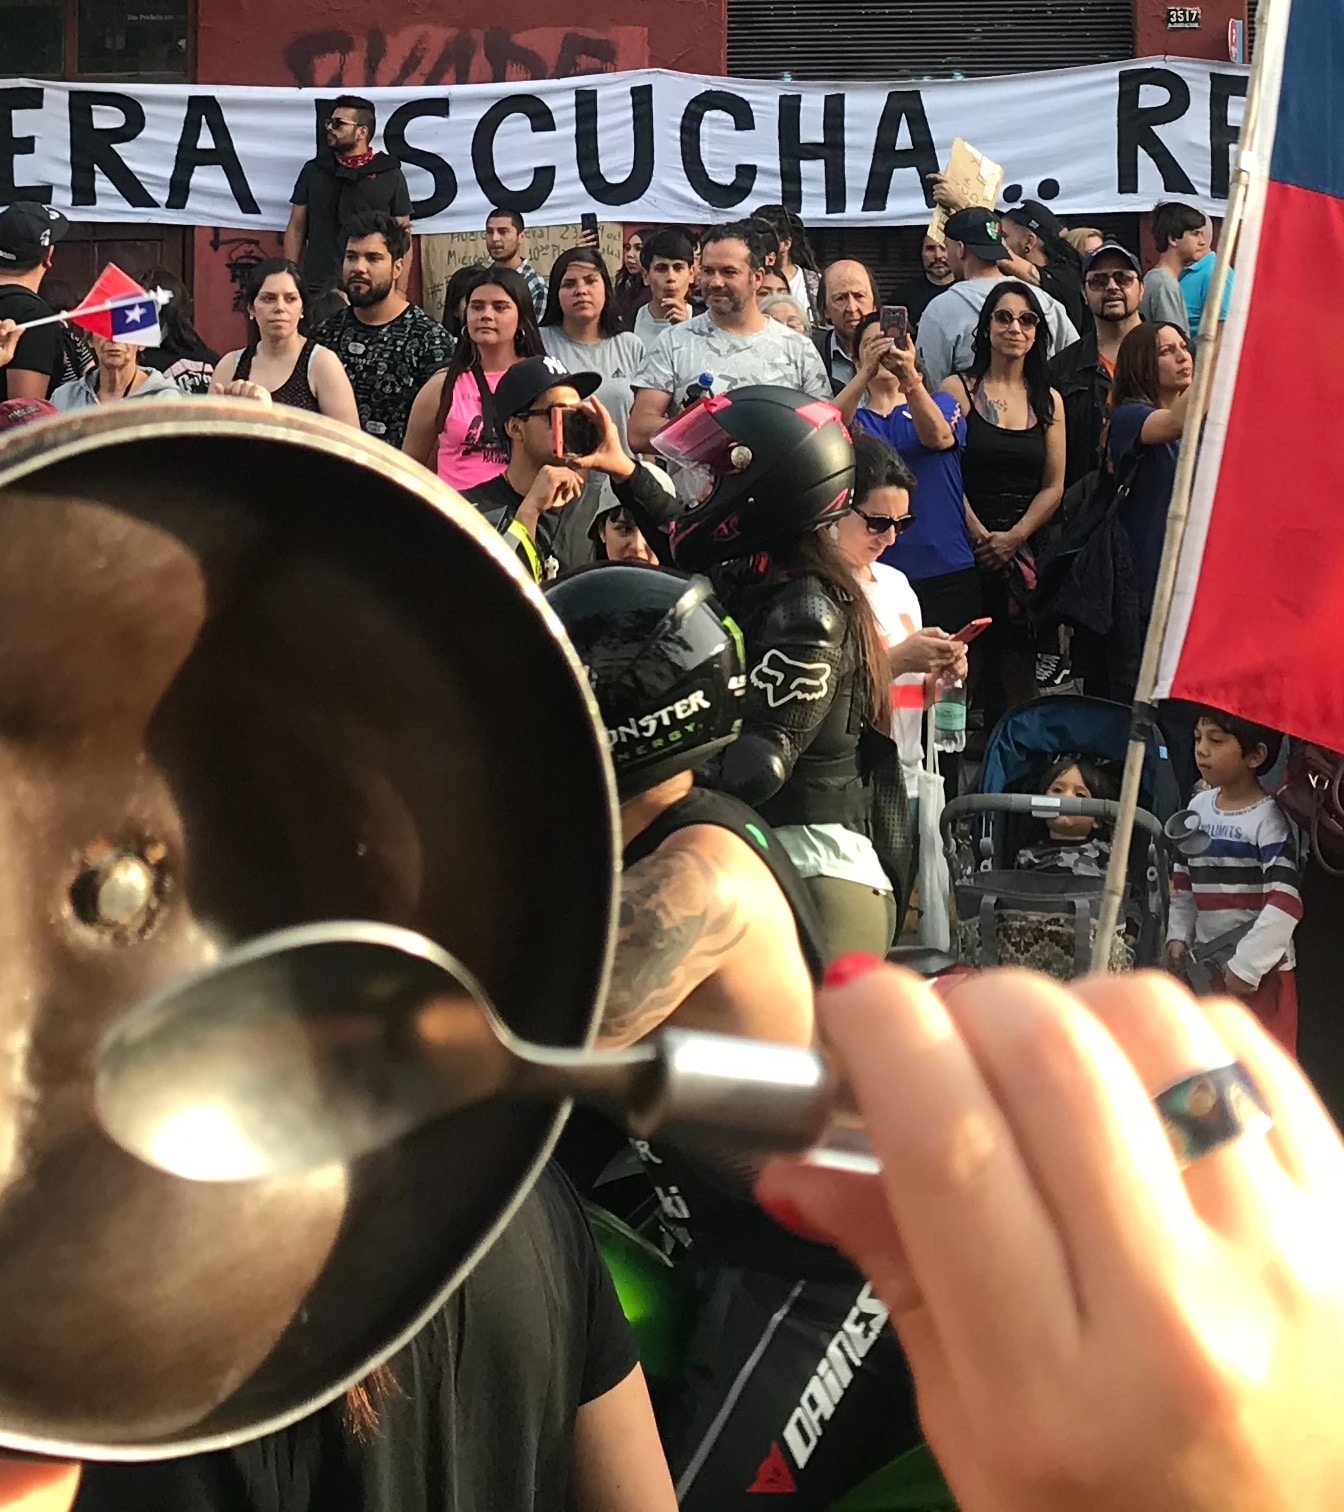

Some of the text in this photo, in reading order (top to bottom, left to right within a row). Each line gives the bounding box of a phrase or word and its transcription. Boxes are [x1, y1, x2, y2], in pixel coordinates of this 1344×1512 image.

[1169, 10, 1198, 23] 3517
[606, 689, 711, 747] ONSTER
[616, 721, 696, 762] NERGY
